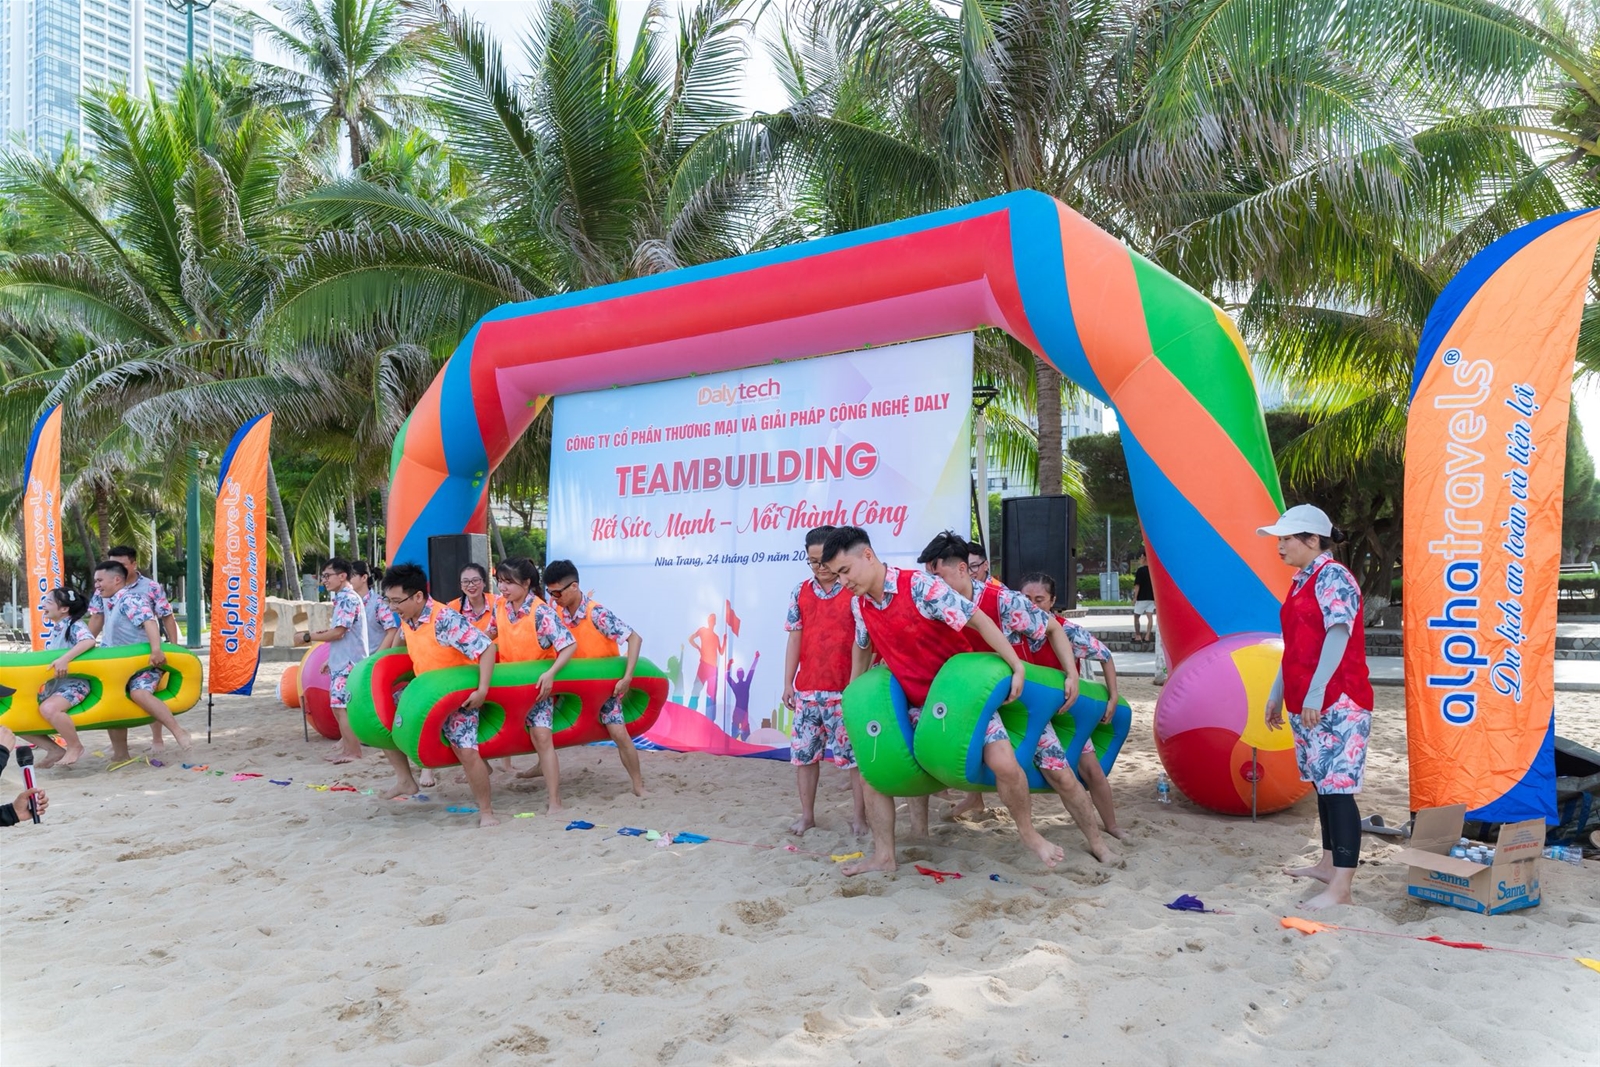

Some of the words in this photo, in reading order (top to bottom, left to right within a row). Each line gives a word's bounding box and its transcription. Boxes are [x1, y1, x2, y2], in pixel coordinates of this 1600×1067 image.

[566, 434, 595, 452] CÔNG
[598, 434, 611, 449] TY
[613, 426, 630, 447] CỔ
[631, 424, 662, 446] PHẦN
[665, 422, 711, 442] THƯƠNG
[714, 418, 738, 437] MẠI
[741, 414, 757, 432] VÀ
[761, 409, 787, 431] GIẢI
[790, 406, 826, 427] PHÁP
[829, 402, 868, 422] CÔNG
[871, 395, 910, 418] NGHỆ
[914, 392, 950, 413] DALY
[1504, 383, 1537, 417] lợi
[1505, 418, 1537, 466] tiện
[614, 441, 879, 497] TEAMBUILDING
[1502, 467, 1529, 500] và
[590, 514, 618, 541] Kết
[620, 516, 652, 540] Sức
[655, 508, 716, 540] Mạnh
[737, 502, 782, 534] Nối
[779, 499, 848, 531] Thành
[851, 499, 909, 537] Công
[1427, 358, 1494, 727] alphatravels
[1500, 502, 1528, 559] toàn
[220, 481, 245, 654] alphatravels
[654, 556, 674, 567] Nha
[676, 555, 704, 567] Trang,
[706, 554, 719, 565] 24
[721, 552, 749, 566] tháng
[752, 552, 765, 563] 09
[767, 551, 790, 562] năm
[792, 550, 809, 562] 20
[1504, 560, 1524, 596] an
[248, 577, 259, 592] an
[1494, 599, 1526, 646] lịch
[1489, 648, 1523, 702] Du
[1497, 880, 1526, 901] Sanna
